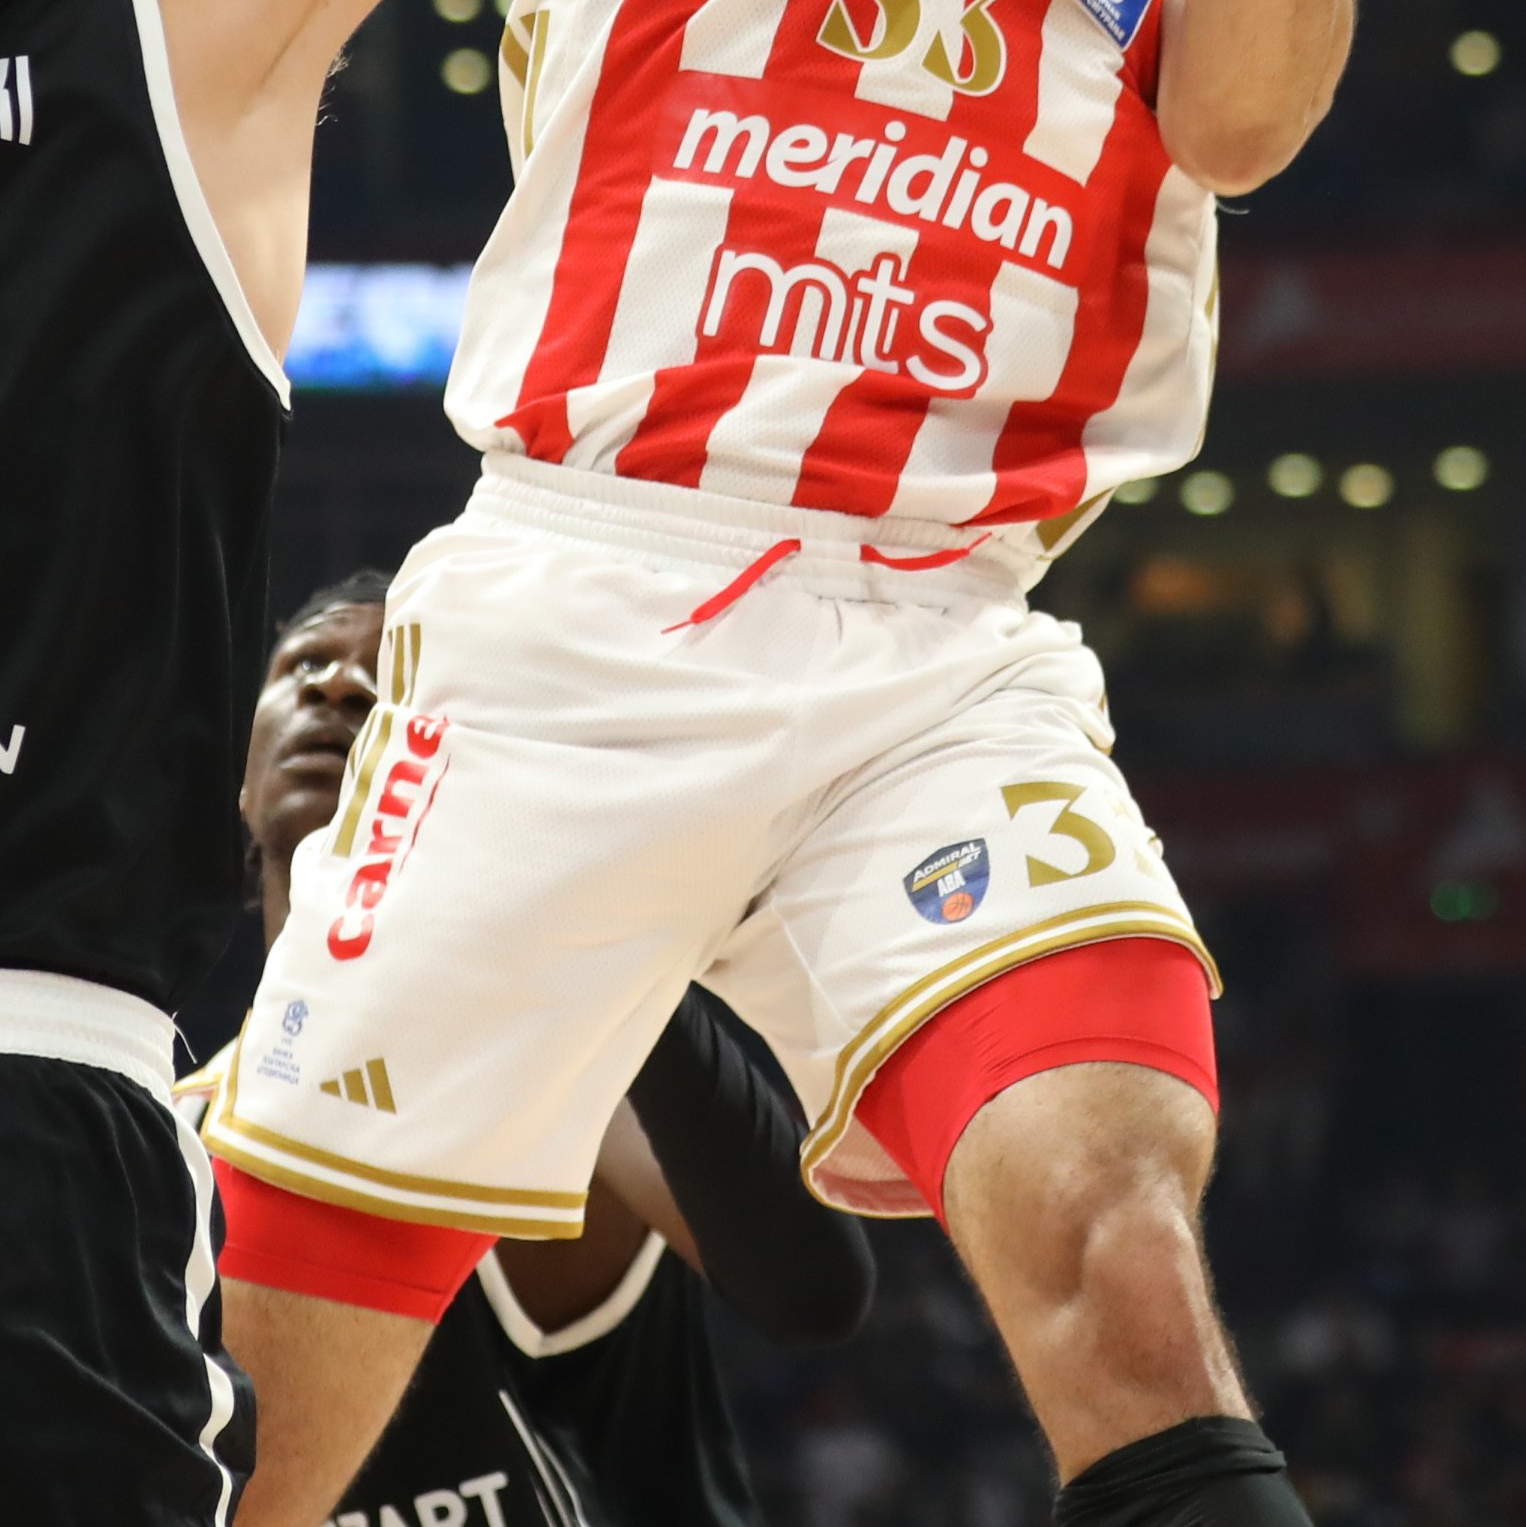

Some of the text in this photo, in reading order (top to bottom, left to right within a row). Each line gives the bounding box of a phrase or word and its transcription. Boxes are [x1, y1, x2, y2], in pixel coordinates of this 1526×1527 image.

[673, 107, 1074, 270] meridian
[702, 249, 989, 392] mts
[913, 842, 982, 883] ADMIRAL
[937, 869, 967, 898] ABA
